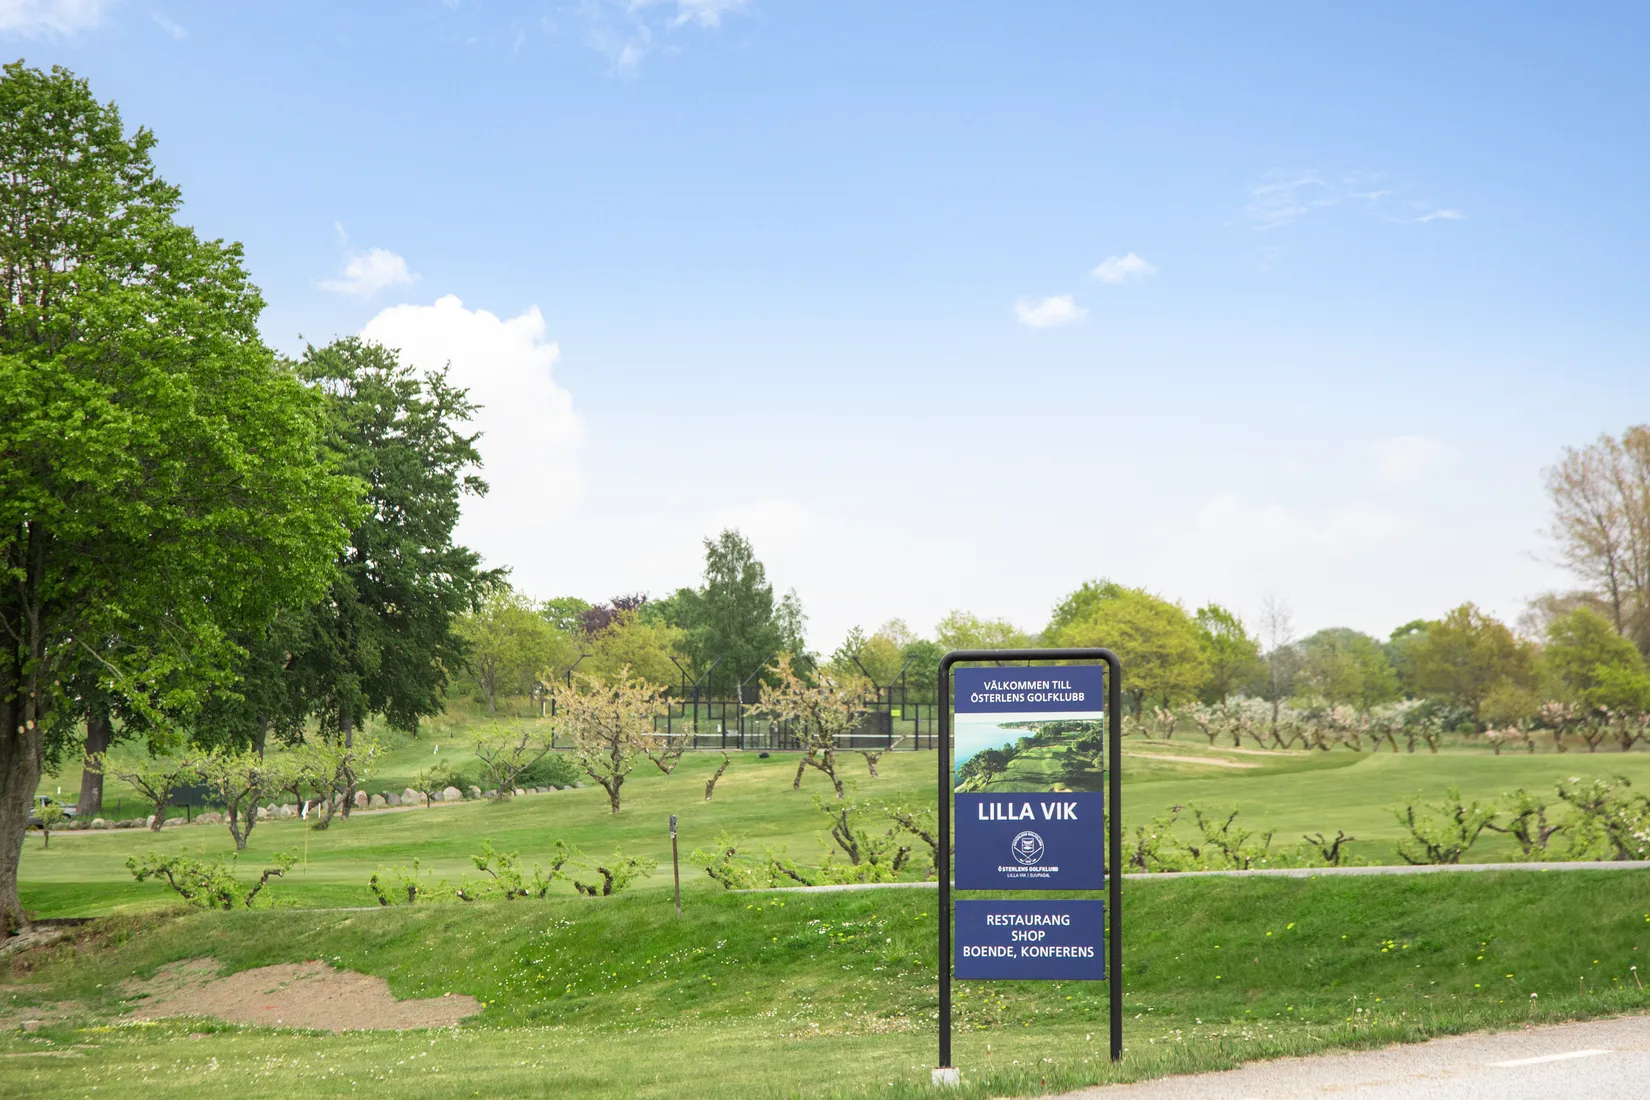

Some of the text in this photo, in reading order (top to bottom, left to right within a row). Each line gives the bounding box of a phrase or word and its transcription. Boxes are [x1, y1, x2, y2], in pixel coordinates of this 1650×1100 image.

[983, 680, 1072, 691] VÄLKOMMEN TILL
[970, 692, 1085, 703] ÖSTERLENS GOLFKLUBB
[978, 802, 1078, 820] LILLA VIK
[986, 914, 1070, 926] RESTAURANG
[1011, 930, 1046, 942] SHOP
[963, 946, 1094, 959] BOENDE, KONFERENS
